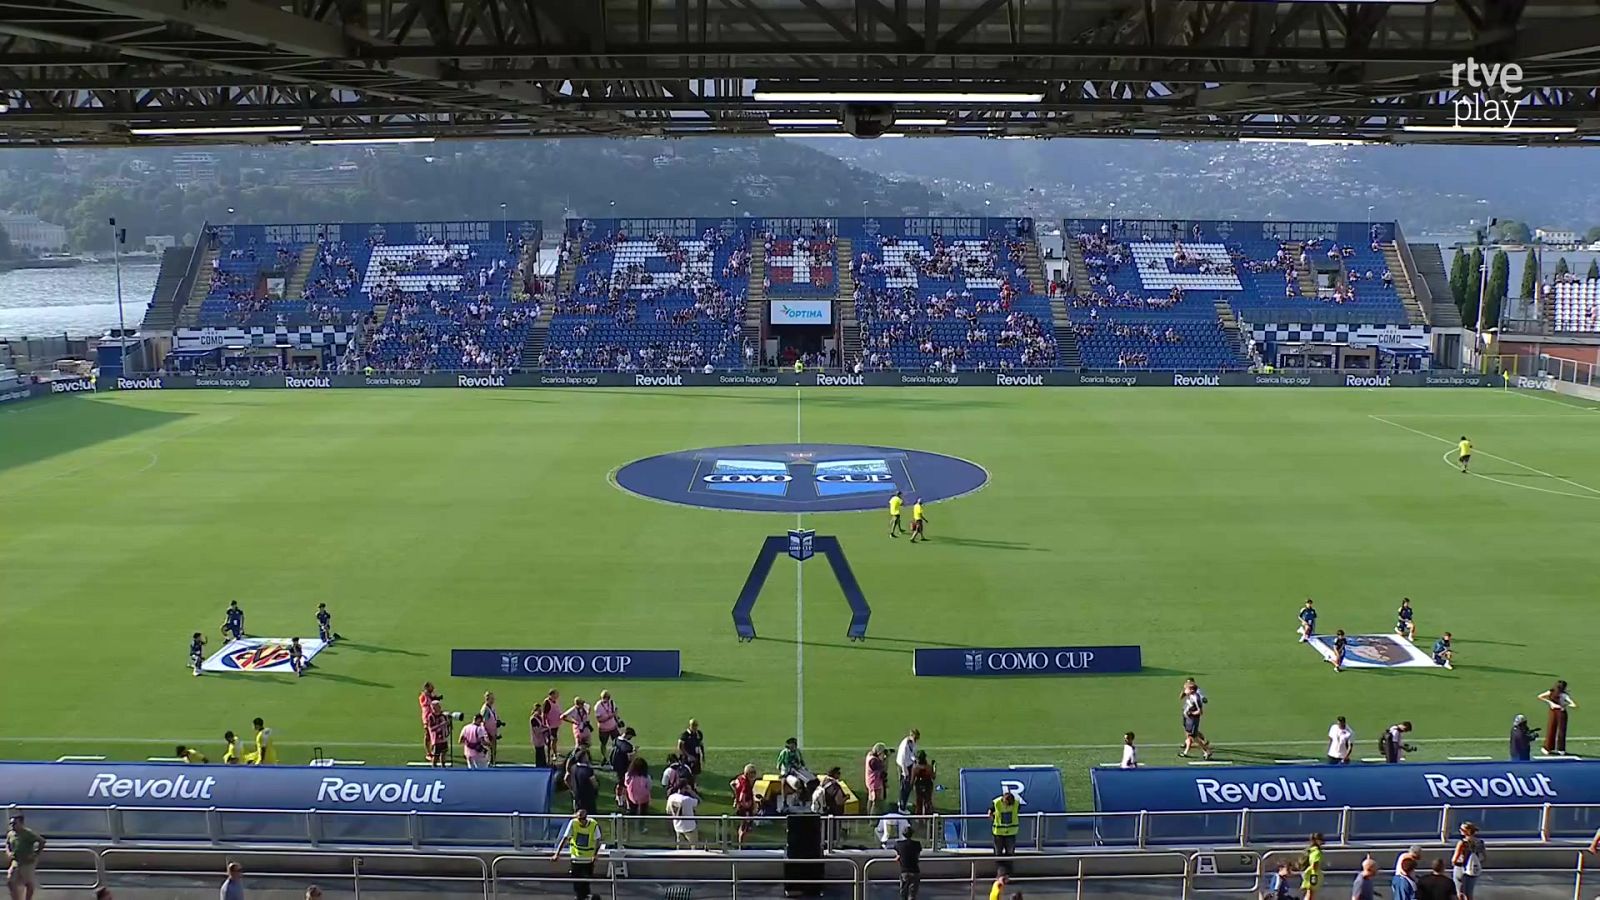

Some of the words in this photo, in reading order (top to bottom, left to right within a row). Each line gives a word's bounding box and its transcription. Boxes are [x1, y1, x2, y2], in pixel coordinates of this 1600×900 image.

[788, 310, 823, 318] OPTIMA
[200, 335, 224, 345] COMO
[1378, 334, 1401, 344] COMO
[117, 377, 162, 389] Revolut
[285, 376, 330, 388] Revolut
[458, 375, 504, 387] Revolut
[635, 374, 682, 386] Revolut
[816, 373, 864, 386] Revolut
[996, 373, 1043, 386] Revolut
[1174, 374, 1220, 386] Revolut
[1346, 374, 1391, 386] Revolut
[703, 474, 793, 483] COMO
[816, 474, 893, 483] CUP
[523, 655, 585, 673] COMO
[591, 655, 632, 673] CUP
[987, 652, 1049, 670] COMO
[1055, 651, 1094, 669] CUP
[88, 773, 218, 799] Revolut
[317, 777, 446, 804] Revolut
[1196, 776, 1327, 804] Revolut
[1423, 772, 1557, 799] Revolut
[1000, 780, 1028, 805] R
